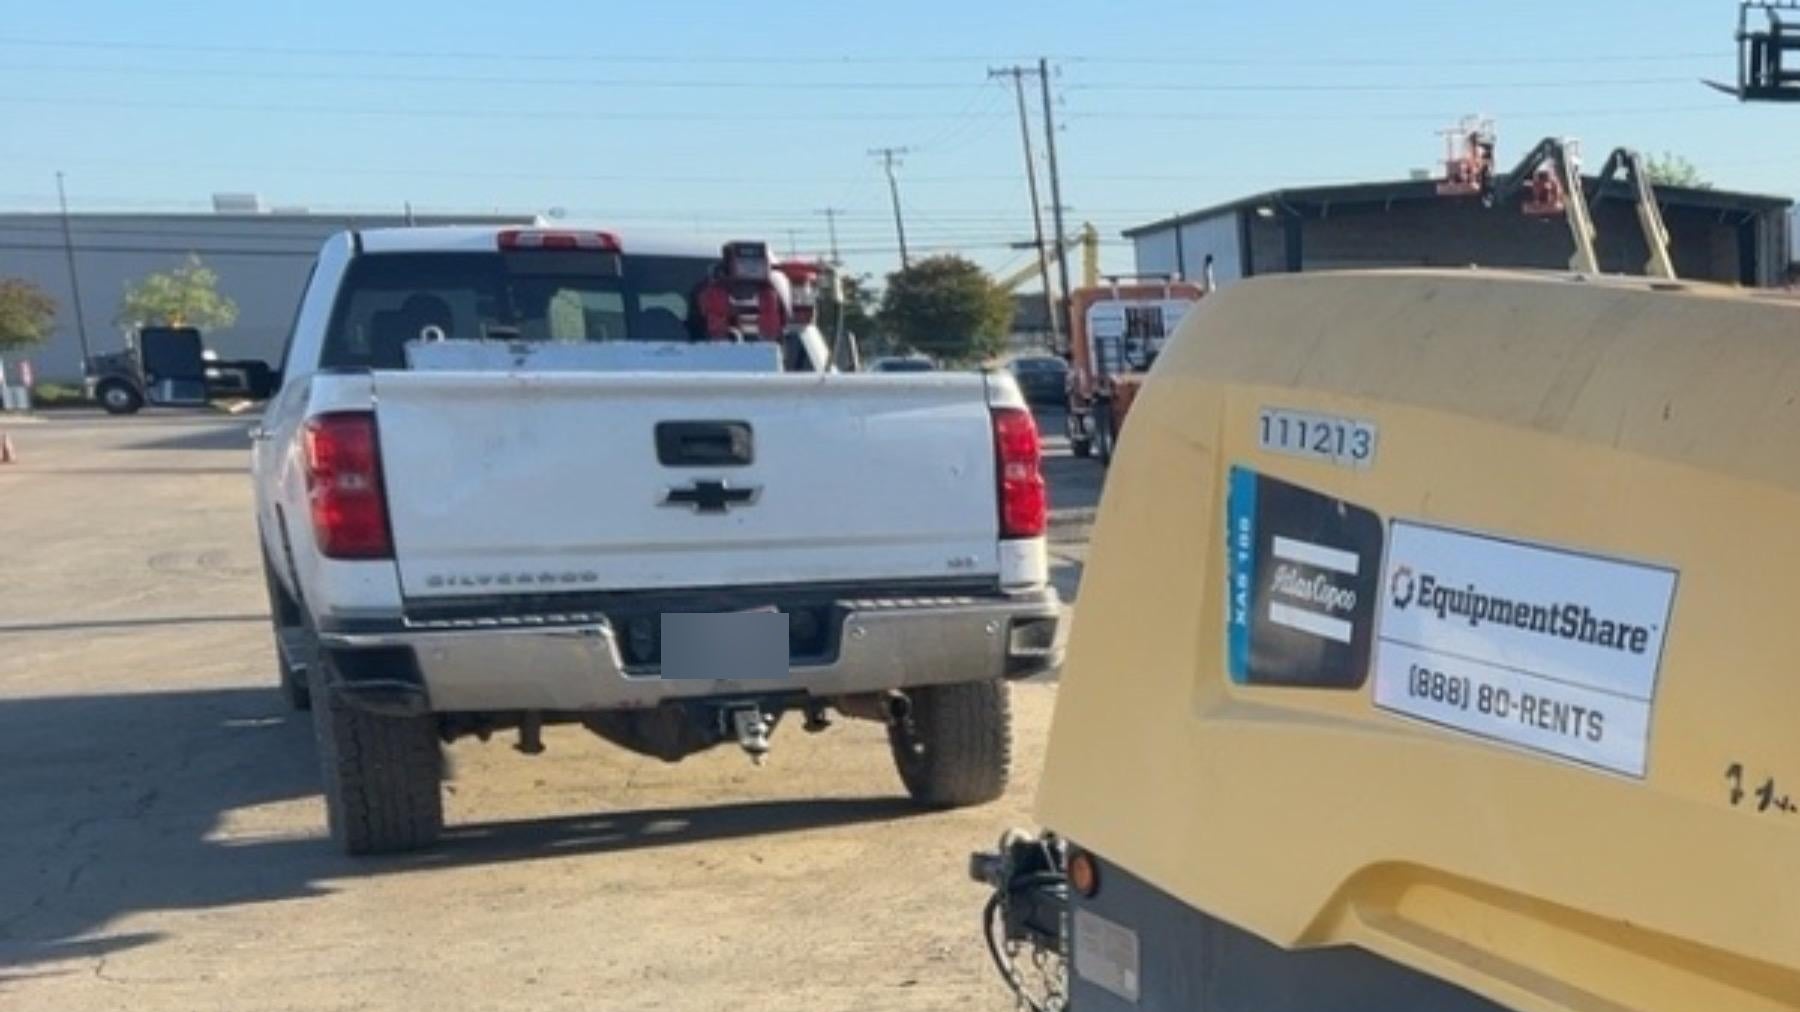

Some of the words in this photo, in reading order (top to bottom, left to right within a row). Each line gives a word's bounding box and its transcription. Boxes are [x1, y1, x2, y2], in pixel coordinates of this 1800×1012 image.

[1261, 415, 1371, 460] 111213
[1416, 574, 1649, 654] EquipmentShare
[1410, 663, 1471, 711] (888)
[1477, 682, 1605, 742] 80-RENTS
